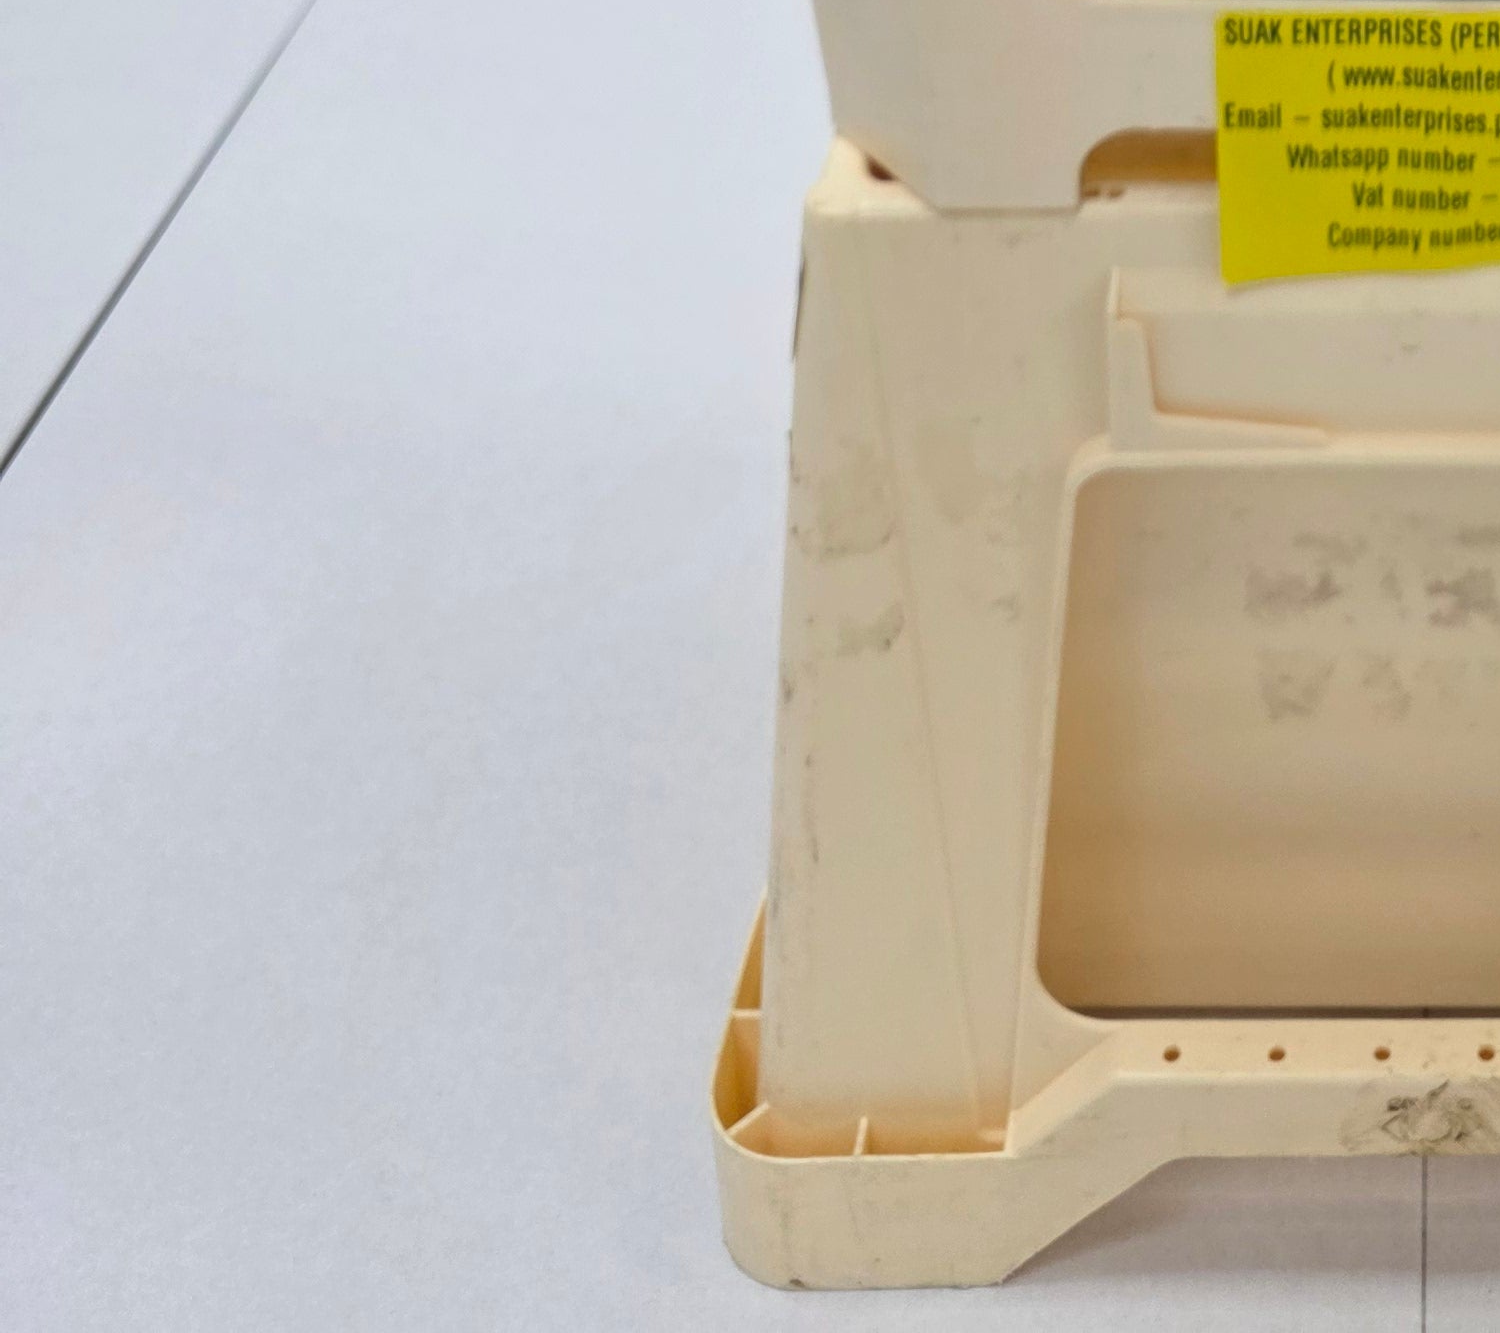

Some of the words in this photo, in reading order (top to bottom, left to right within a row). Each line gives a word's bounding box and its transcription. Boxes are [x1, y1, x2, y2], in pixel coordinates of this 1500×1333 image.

[1225, 18, 1281, 45] SUAK
[1292, 18, 1442, 47] ENTERPRISES
[1327, 60, 1335, 92] (
[1224, 102, 1281, 130] Email
[1287, 144, 1389, 173] Whatsapp
[1397, 147, 1476, 173] number
[1352, 182, 1384, 208] Vat
[1392, 187, 1470, 212] number
[1327, 222, 1421, 254] Company
